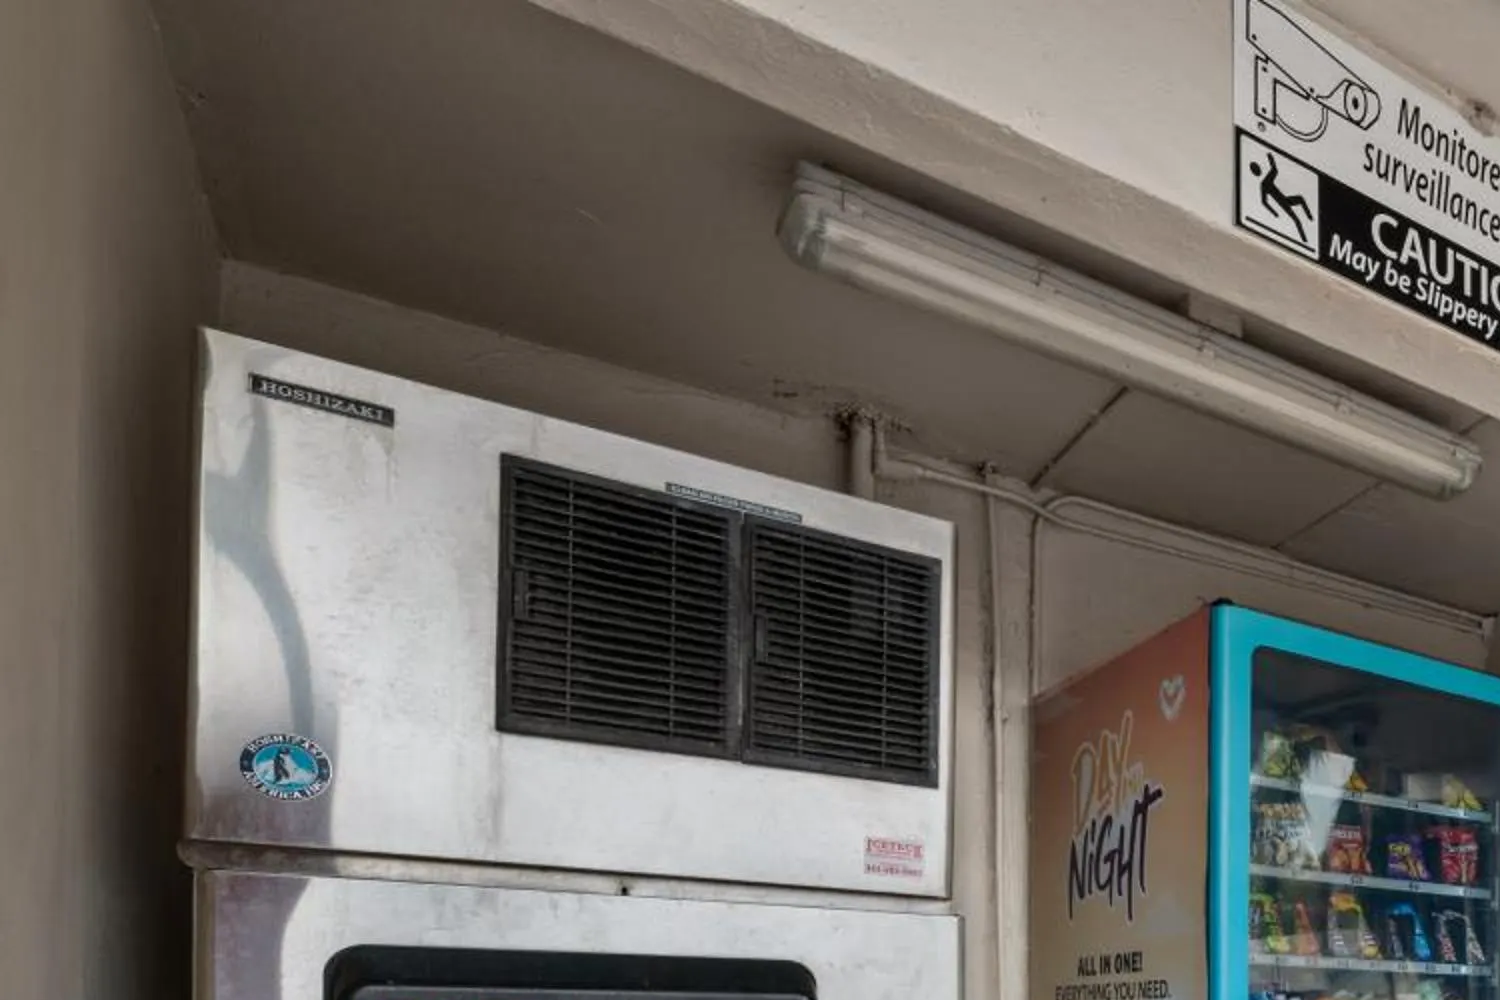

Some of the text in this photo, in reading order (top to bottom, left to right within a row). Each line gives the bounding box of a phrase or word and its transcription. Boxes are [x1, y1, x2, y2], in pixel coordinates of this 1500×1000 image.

[1363, 142, 1500, 243] surveillance
[1329, 233, 1380, 281] May
[1384, 264, 1411, 293] be
[1415, 277, 1498, 338] Slippery
[259, 379, 386, 421] HOSHIZAKI
[1077, 951, 1143, 976] ALL IN ONE!
[1113, 981, 1135, 1000] YOU
